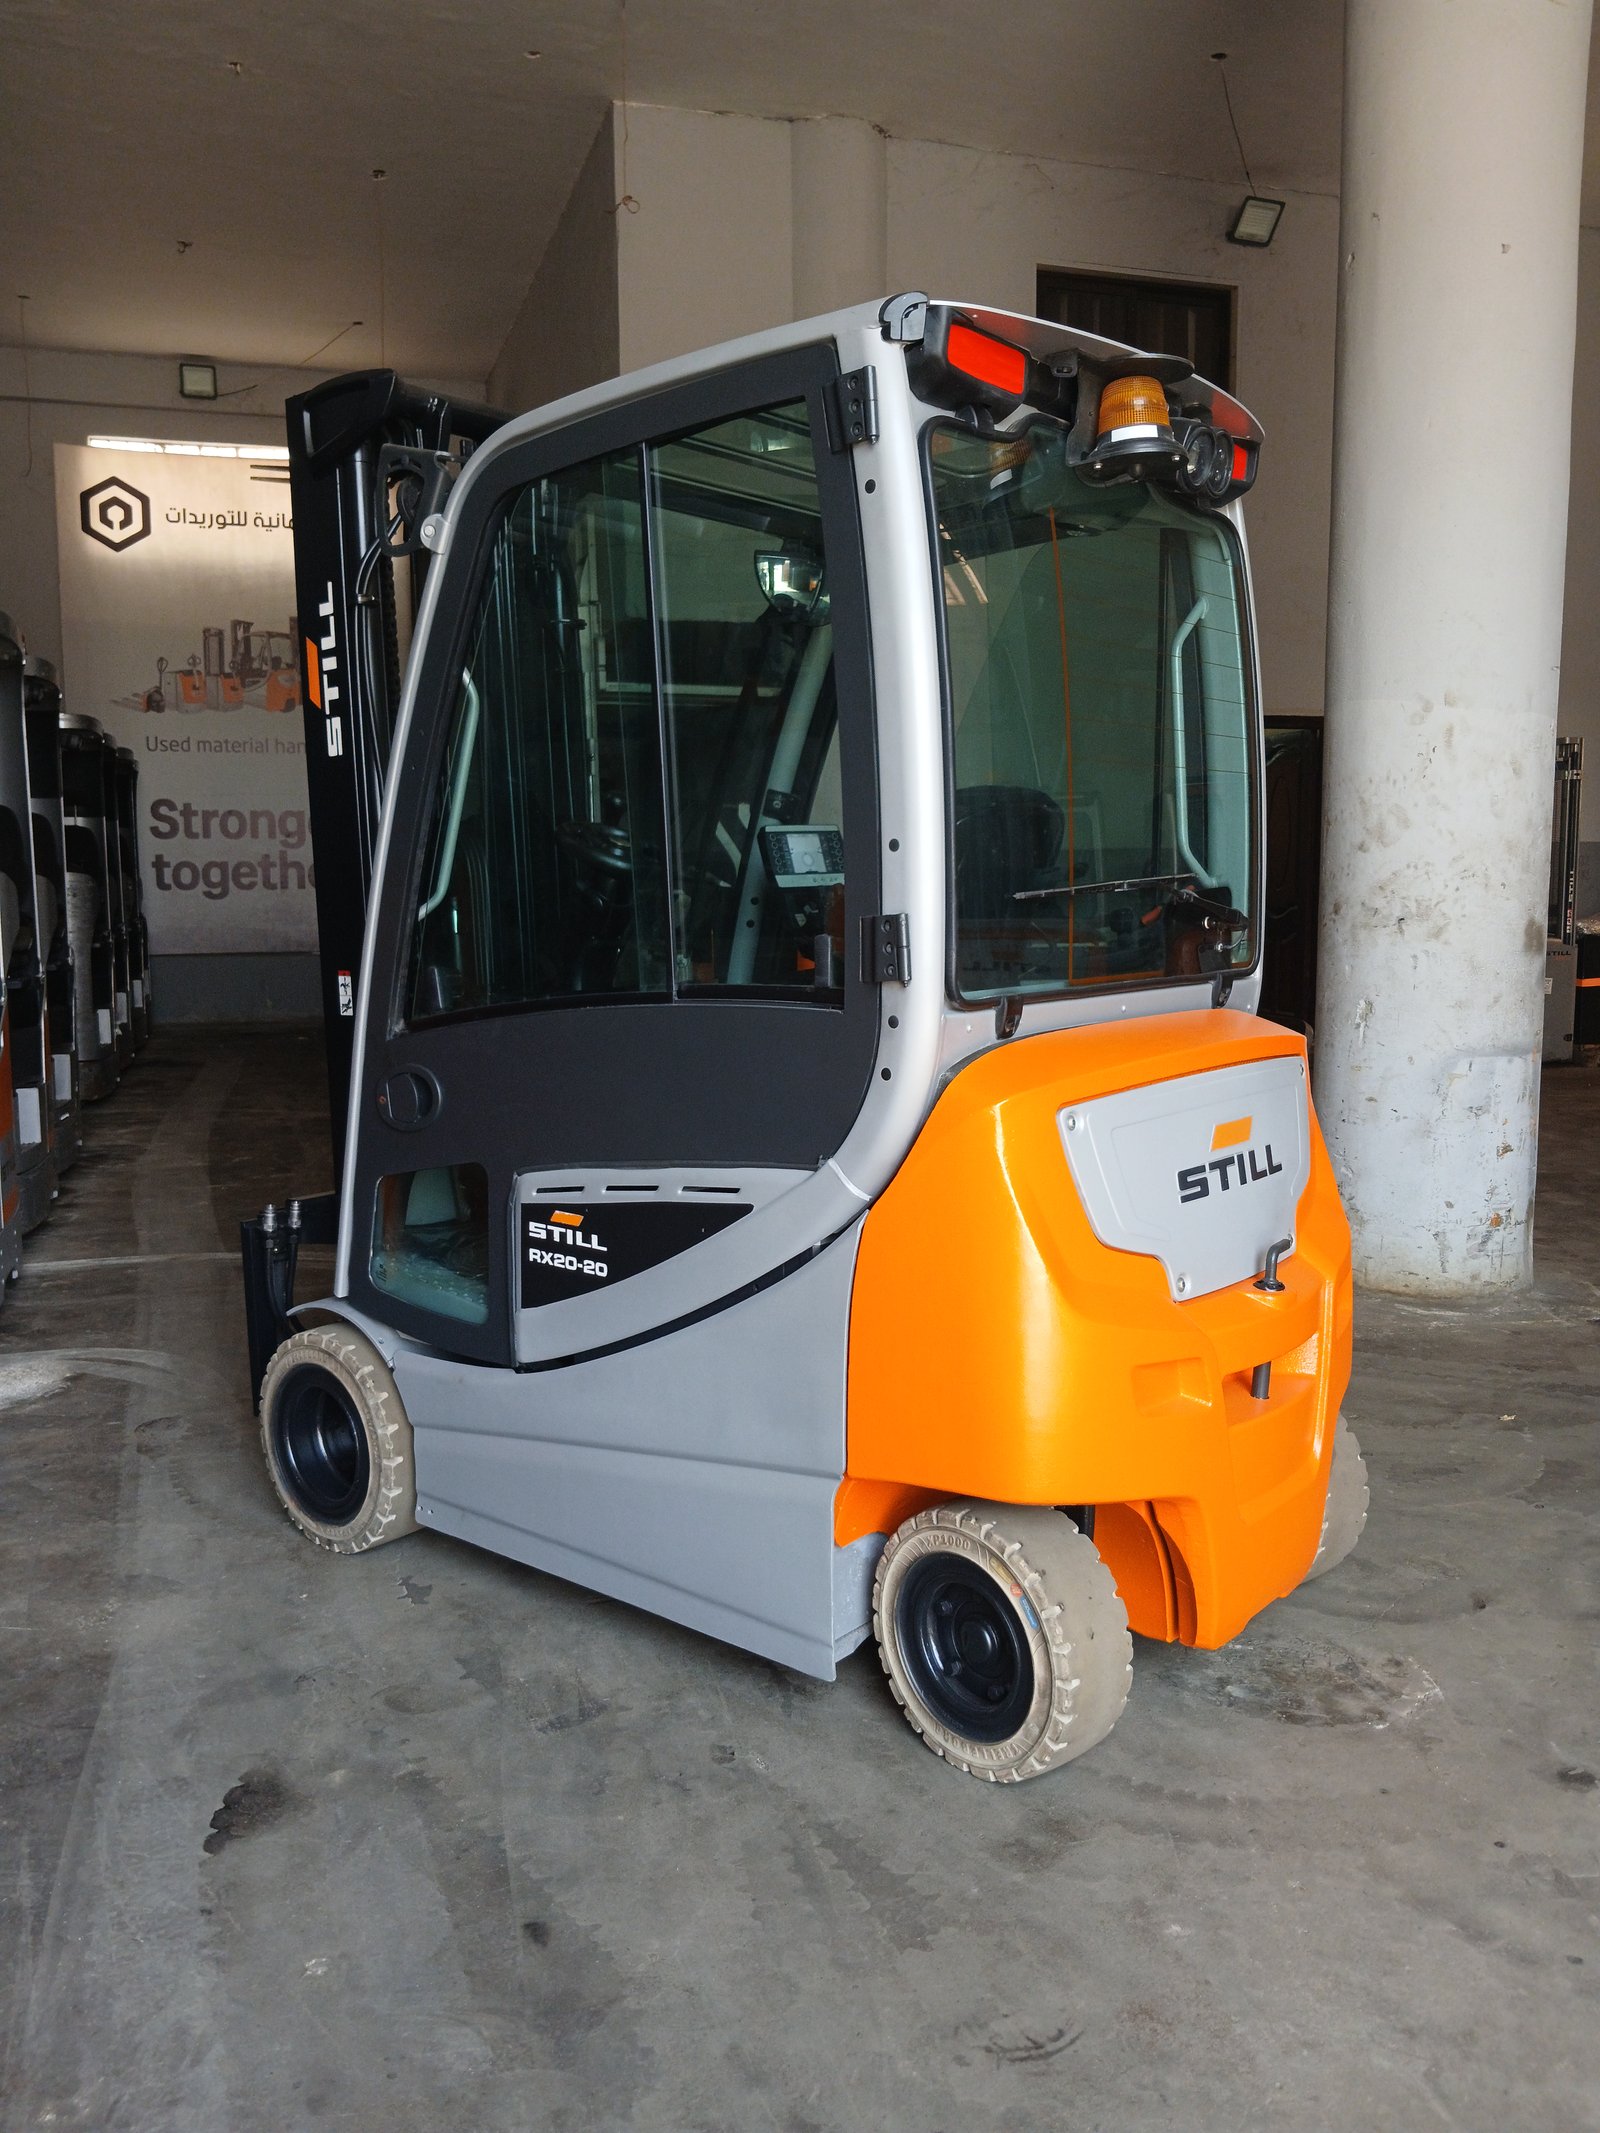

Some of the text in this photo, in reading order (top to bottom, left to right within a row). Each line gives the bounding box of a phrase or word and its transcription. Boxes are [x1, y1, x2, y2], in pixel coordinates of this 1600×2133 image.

[166, 507, 247, 530] للتوريدات
[319, 581, 343, 757] STILL
[146, 736, 191, 752] Used
[197, 737, 269, 754] material
[150, 799, 312, 849] Strong
[1177, 1144, 1282, 1204] STILL
[529, 1221, 608, 1252] STILL
[529, 1248, 608, 1278] RX20-20
[926, 1534, 971, 1551] XP1000
